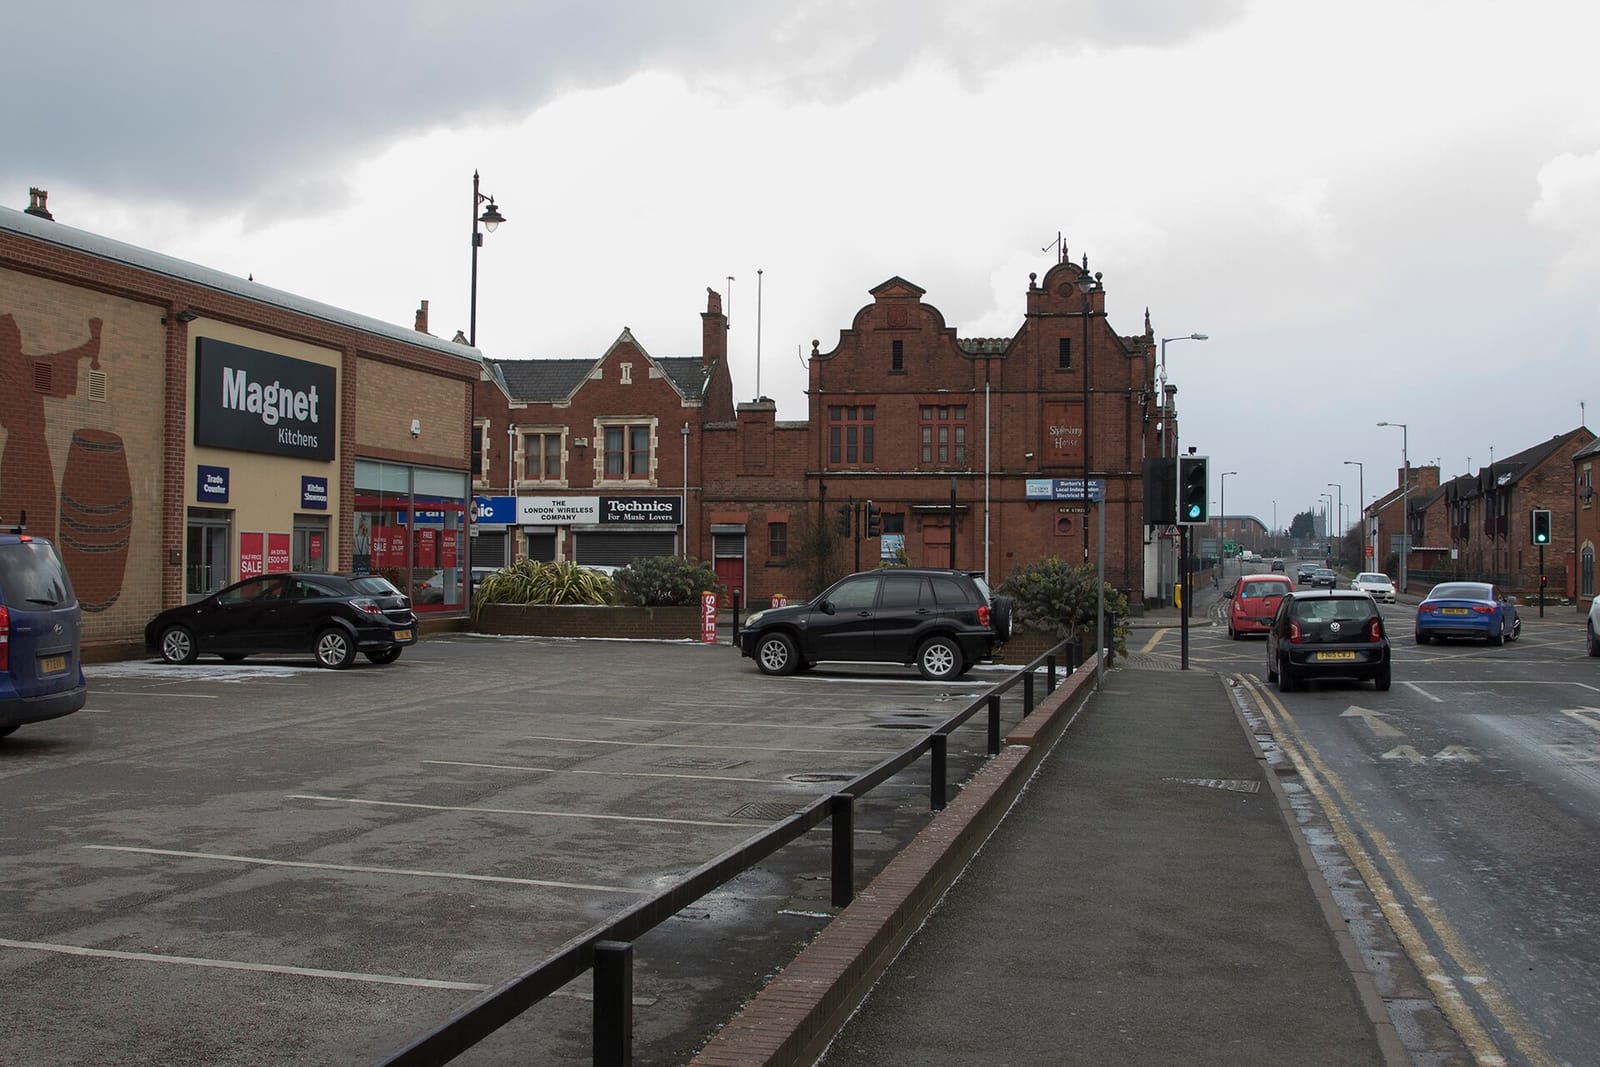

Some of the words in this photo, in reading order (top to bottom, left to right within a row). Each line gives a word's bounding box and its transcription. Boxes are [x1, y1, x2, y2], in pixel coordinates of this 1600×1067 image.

[222, 367, 319, 425] Magnet
[278, 428, 318, 447] Kitchens
[207, 474, 223, 484] Trade
[203, 484, 226, 494] Counter
[607, 500, 673, 512] Technics
[607, 513, 620, 521] For
[623, 513, 645, 521] Music
[649, 513, 673, 521] Lovers
[373, 543, 387, 552] SALE
[281, 556, 289, 564] OFF
[241, 561, 262, 573] SALE
[705, 595, 715, 632] SALE
